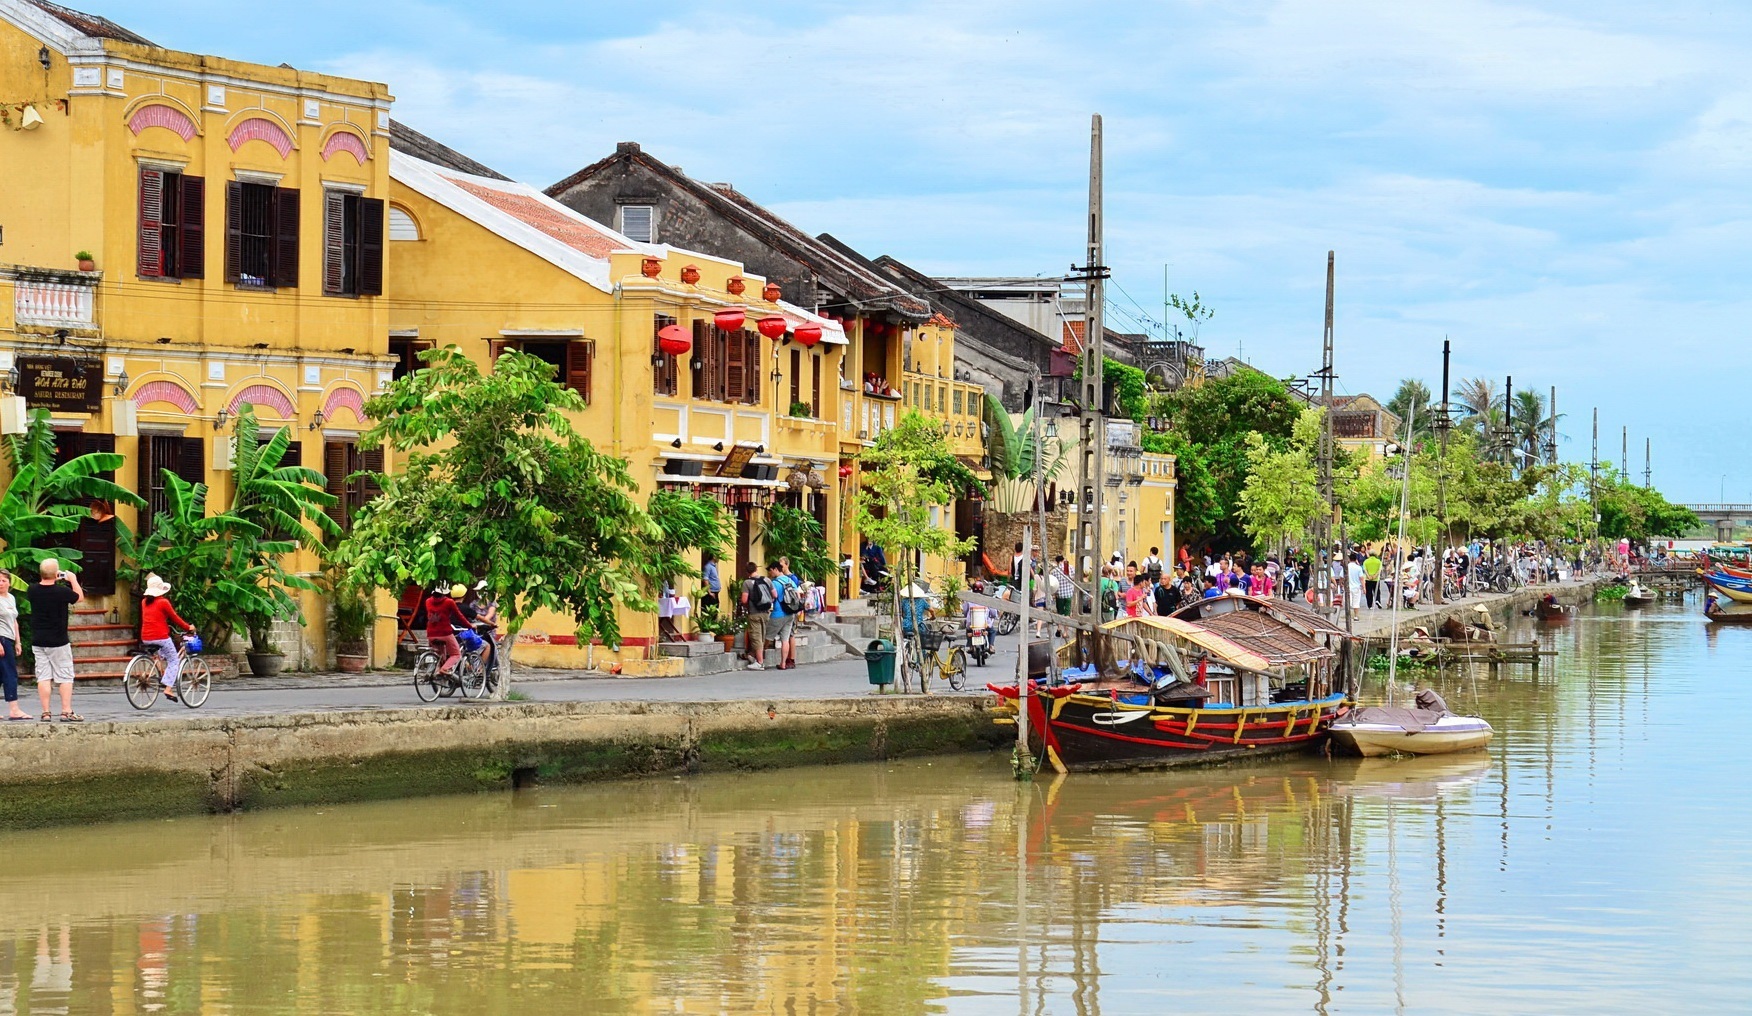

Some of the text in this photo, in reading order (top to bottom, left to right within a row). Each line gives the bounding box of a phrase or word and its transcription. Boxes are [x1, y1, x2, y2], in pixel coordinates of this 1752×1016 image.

[34, 376, 50, 387] HOA
[51, 377, 69, 388] ANH
[54, 391, 85, 399] RESTAURANT
